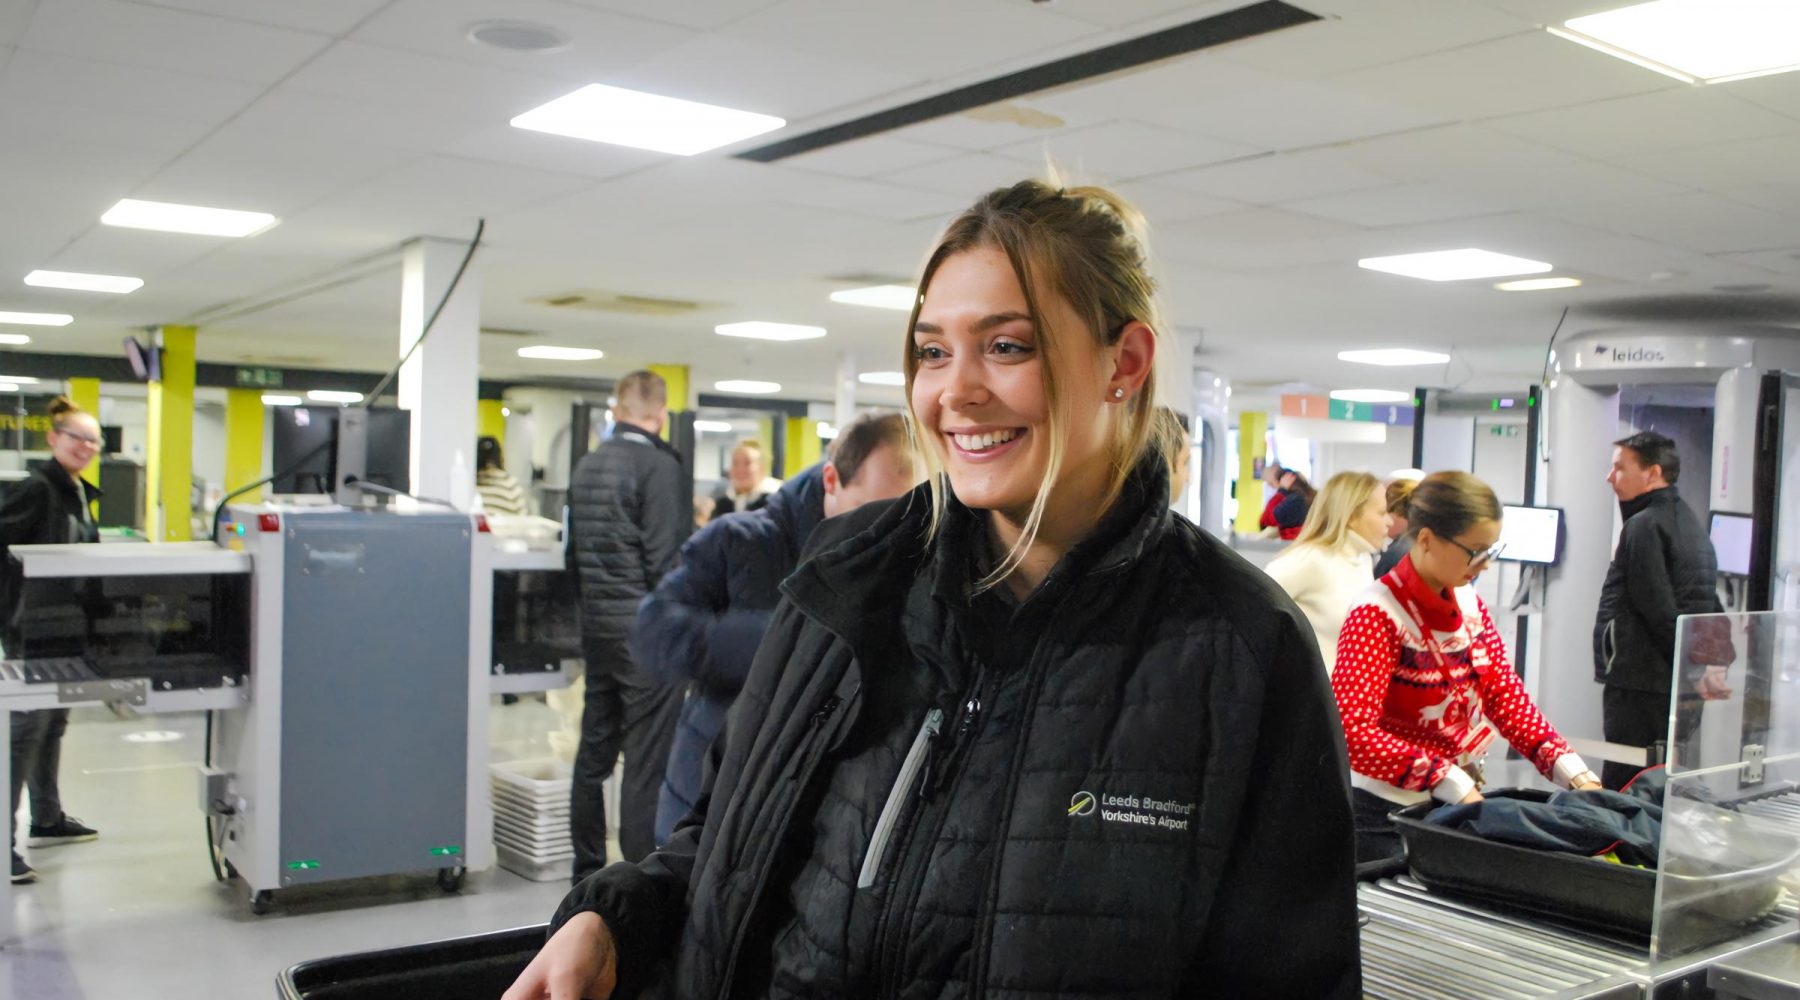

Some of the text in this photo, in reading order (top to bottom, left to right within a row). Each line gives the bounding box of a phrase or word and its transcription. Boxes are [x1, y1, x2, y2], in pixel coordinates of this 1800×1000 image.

[1613, 347, 1664, 361] leidos
[1301, 398, 1398, 424] 1 2 3
[1102, 793, 1139, 808] Leeds
[1101, 809, 1188, 829] Yorkshire's Airport
